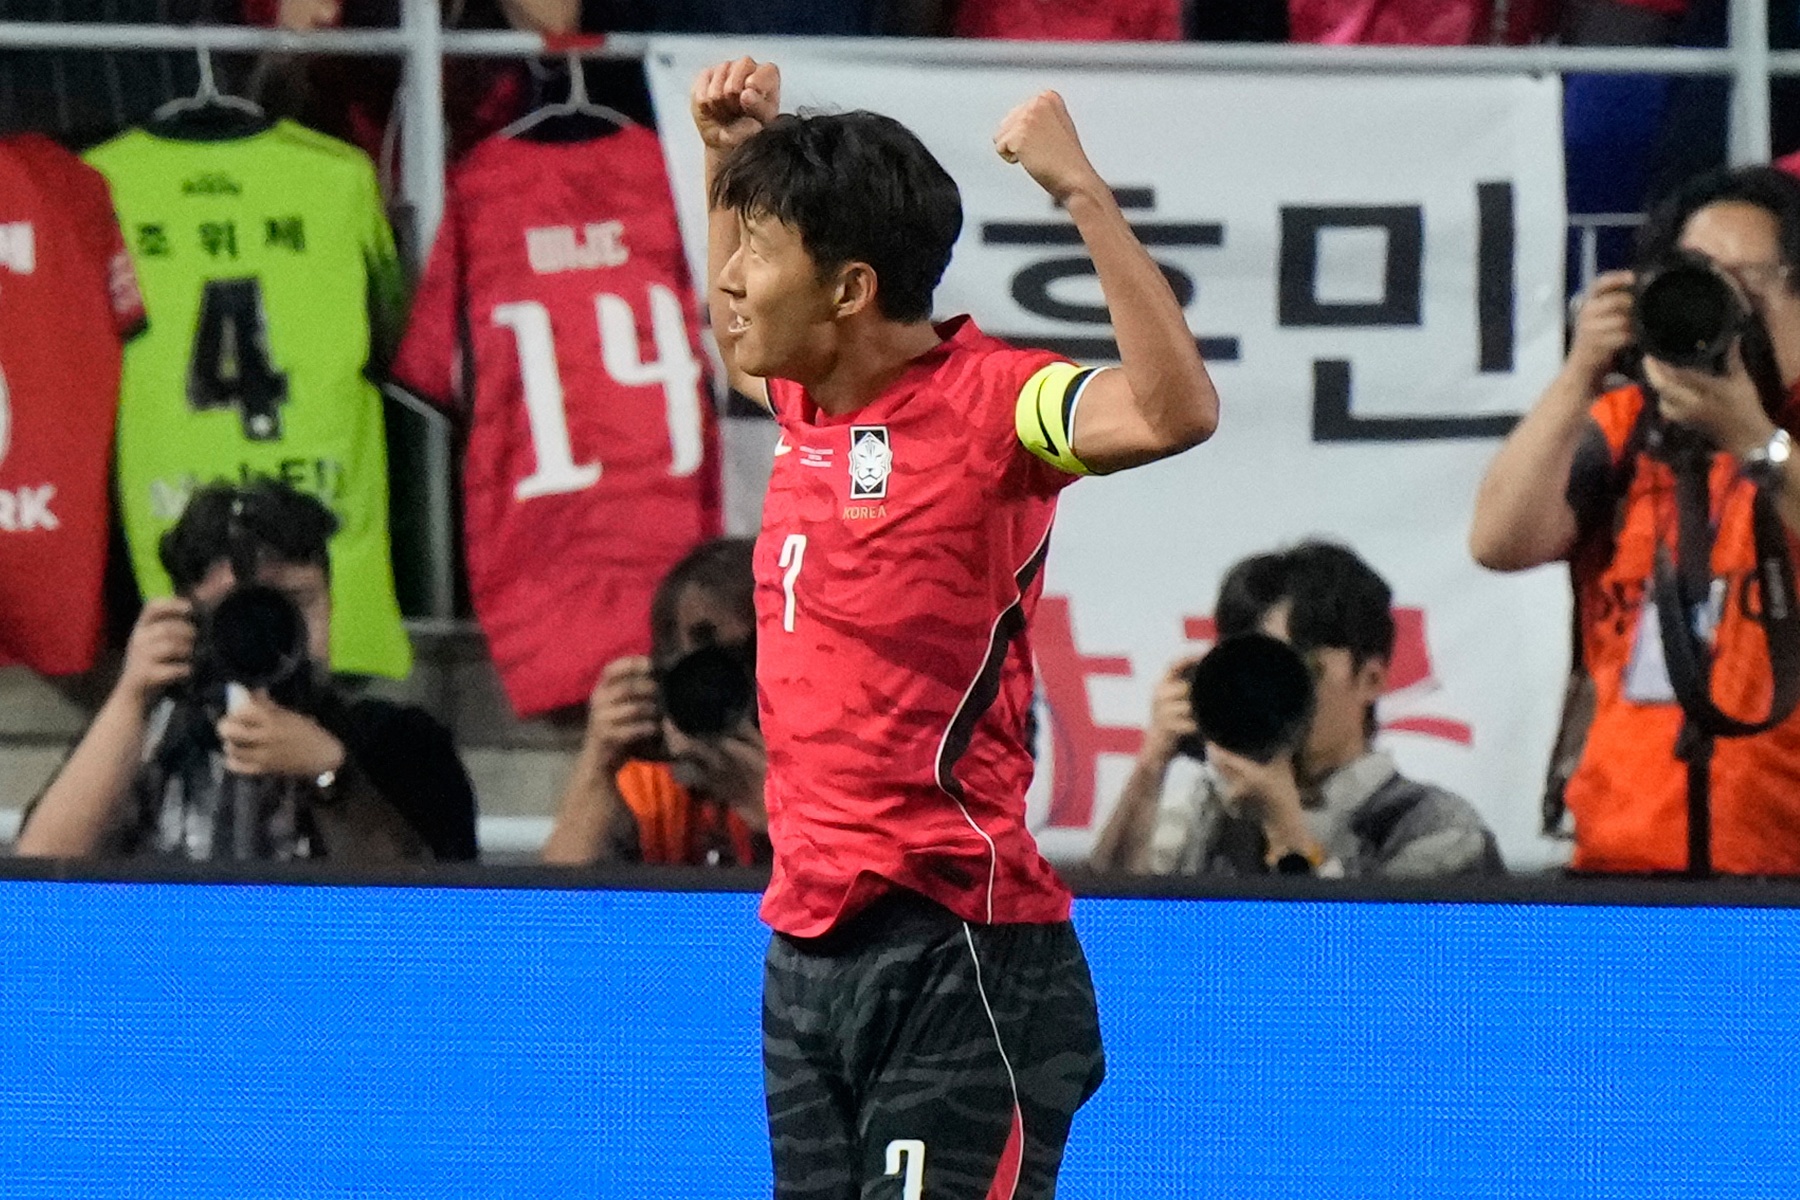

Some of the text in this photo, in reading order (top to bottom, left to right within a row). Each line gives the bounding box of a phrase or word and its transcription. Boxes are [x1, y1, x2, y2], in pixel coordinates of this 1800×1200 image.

[186, 278, 290, 441] 4
[492, 283, 703, 501] 14
[842, 504, 887, 520] KOREA
[778, 534, 807, 632] 7
